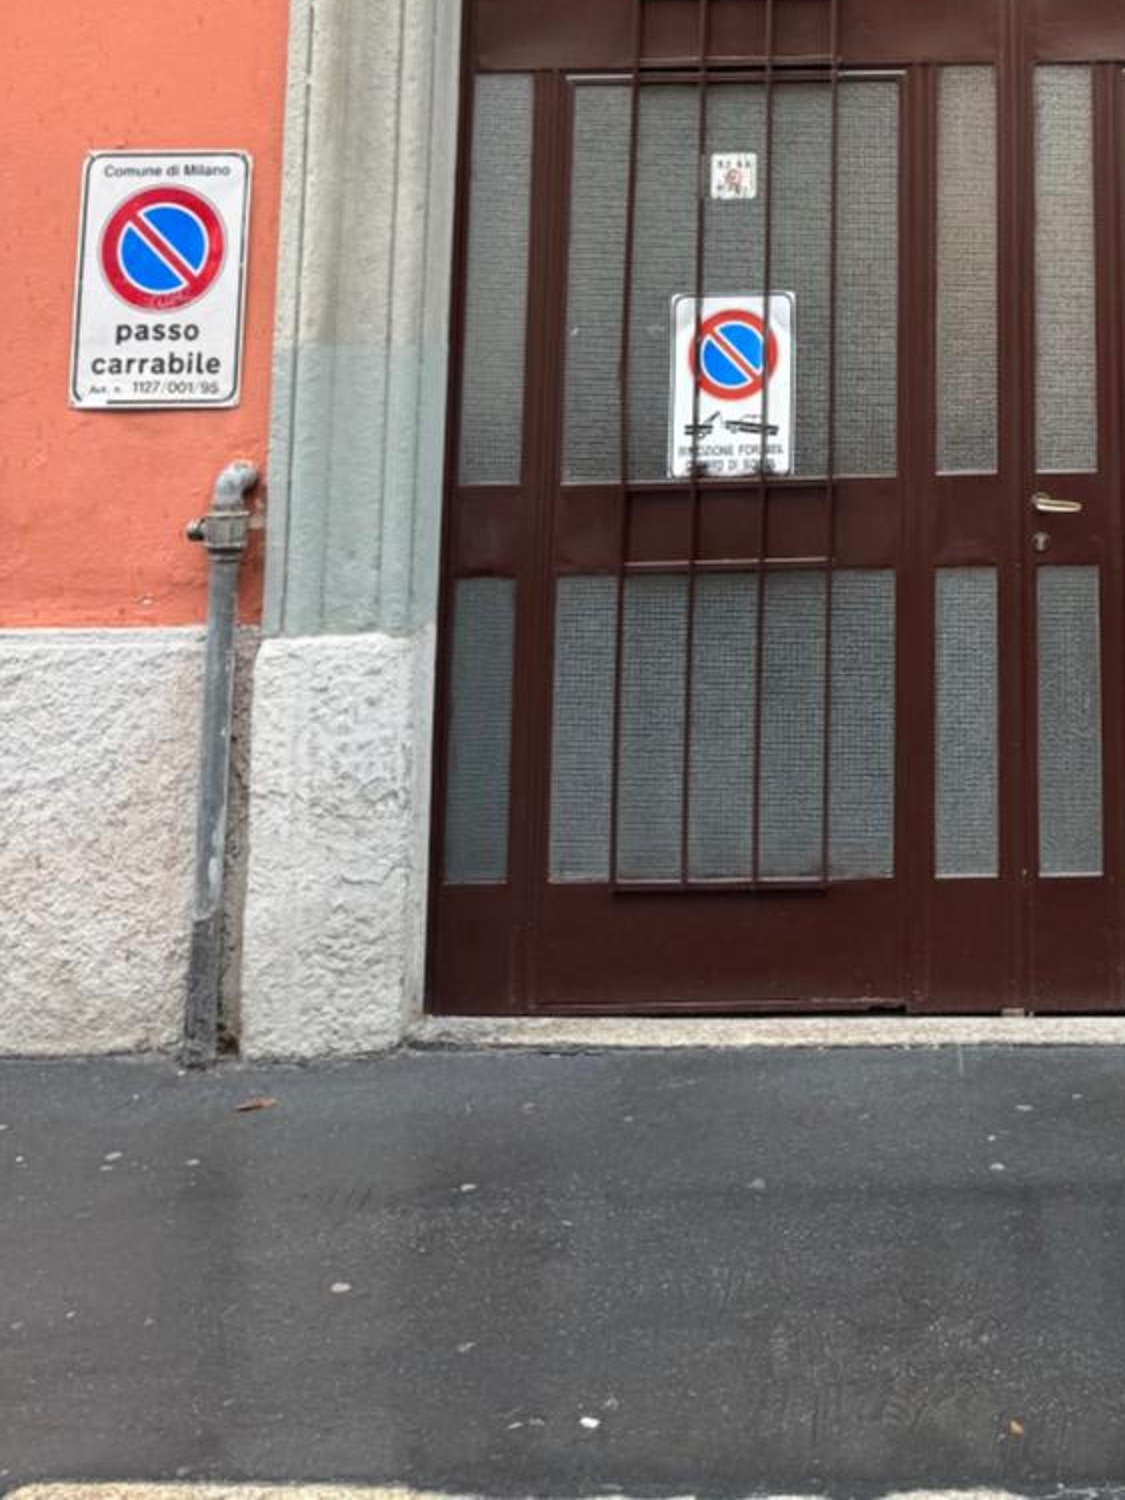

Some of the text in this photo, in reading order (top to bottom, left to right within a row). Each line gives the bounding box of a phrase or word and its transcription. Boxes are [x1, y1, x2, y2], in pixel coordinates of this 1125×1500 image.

[103, 162, 231, 178] Comune di Milano
[115, 322, 200, 345] passo
[90, 351, 221, 375] carrabile
